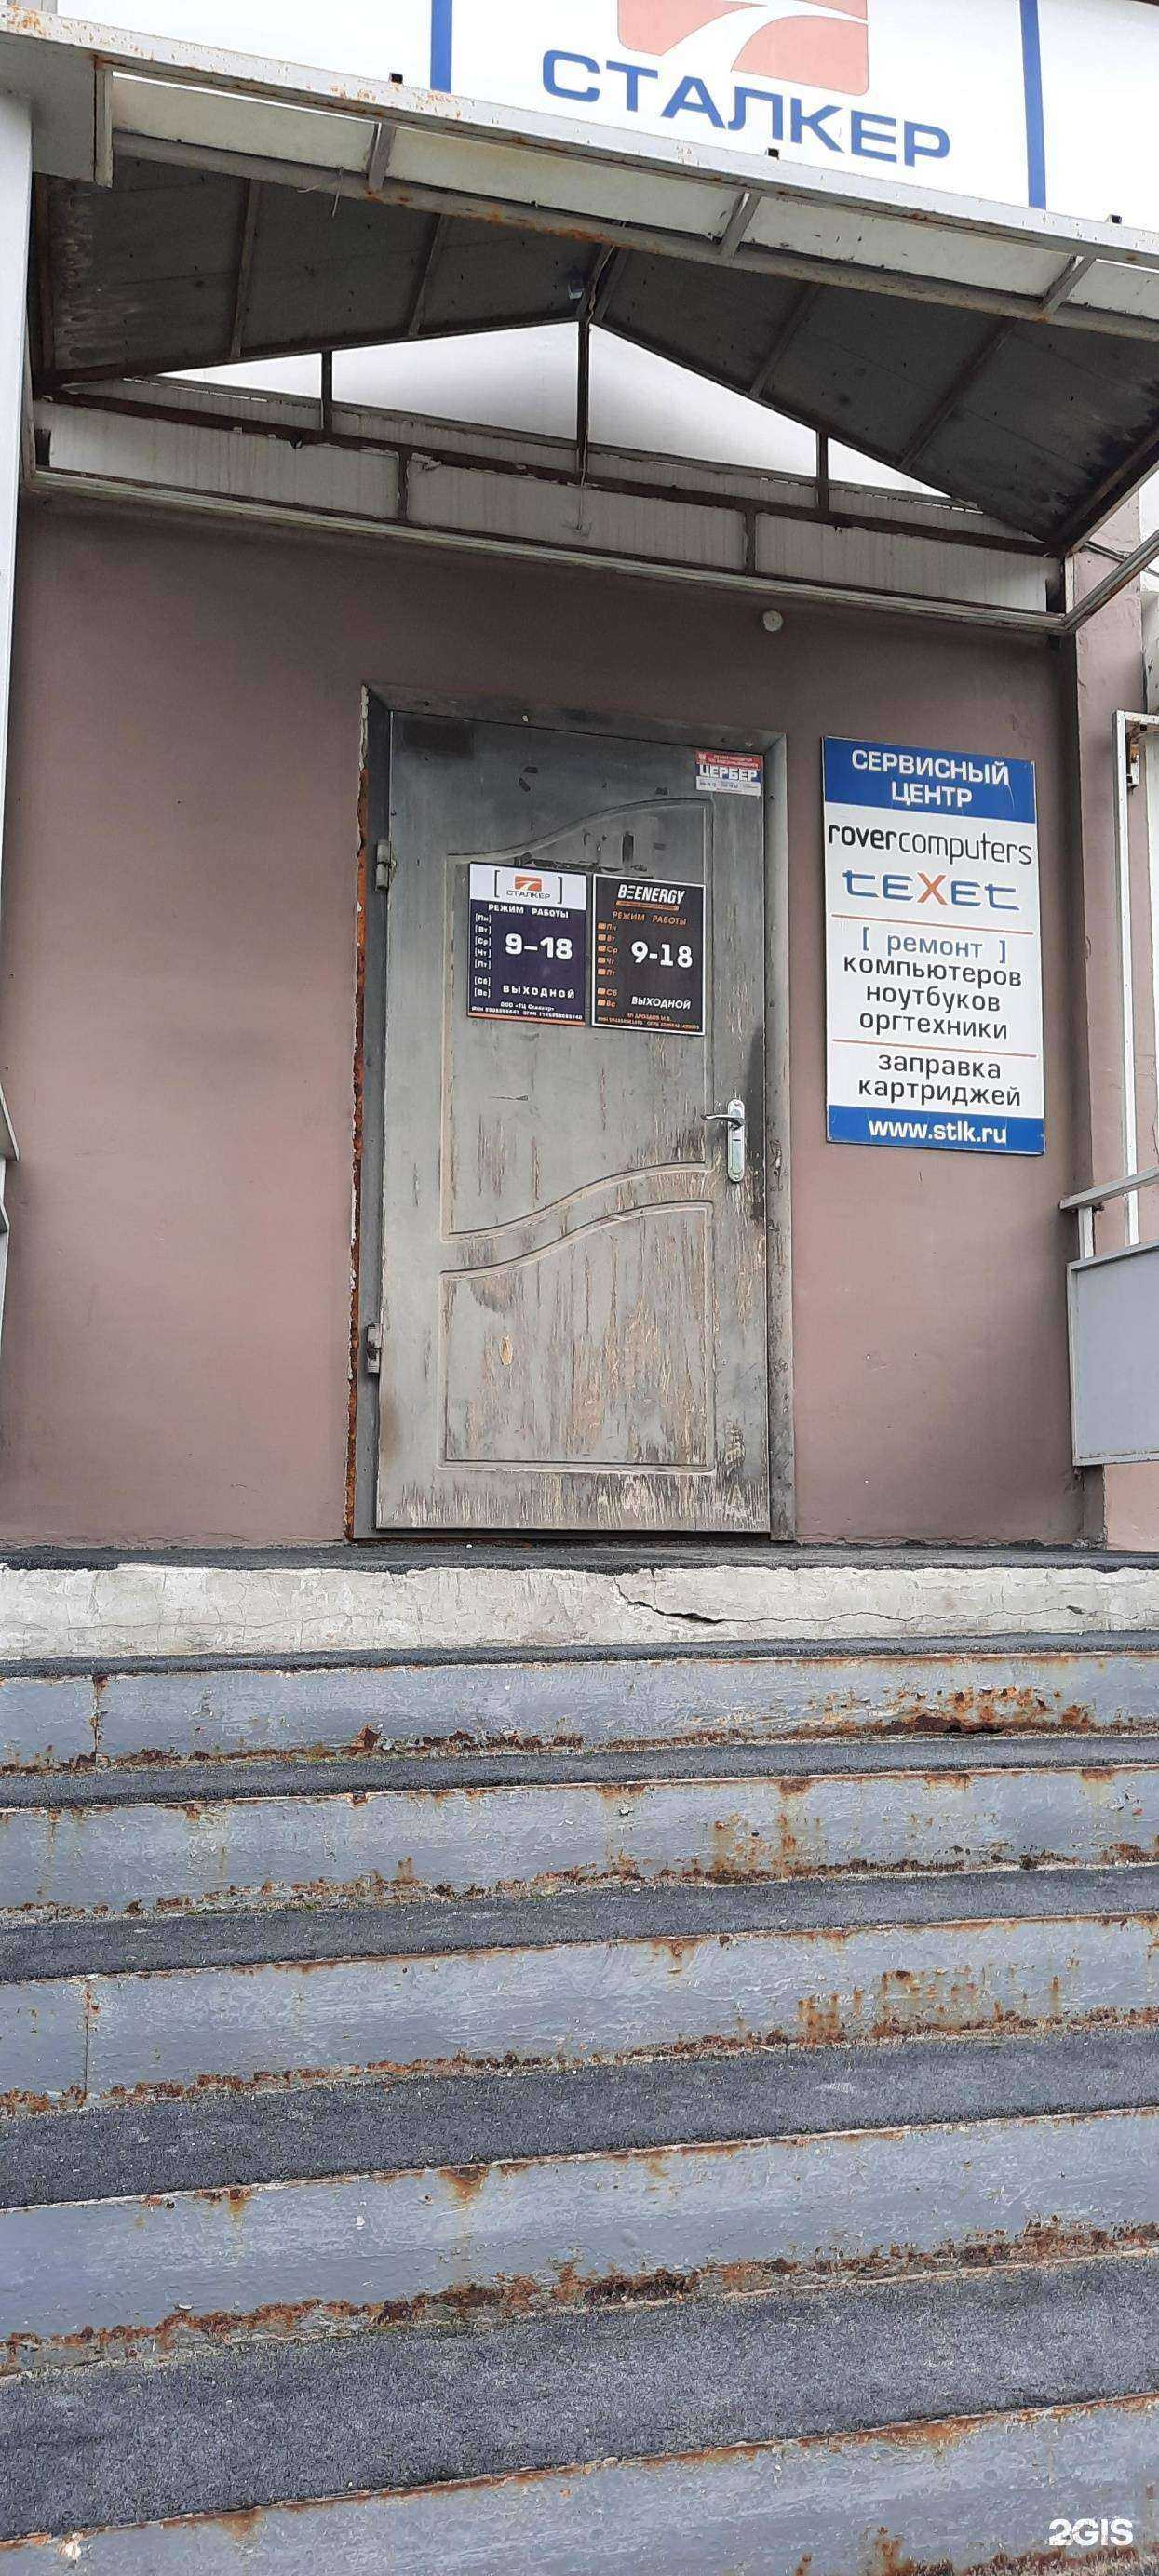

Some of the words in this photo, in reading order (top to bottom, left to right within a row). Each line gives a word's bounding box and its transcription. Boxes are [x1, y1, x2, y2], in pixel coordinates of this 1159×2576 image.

[542, 49, 950, 168] СТАЛКЕР
[699, 764, 758, 782] ЦЕРБЕР
[851, 749, 1010, 785] СЕРВИСНЫЙ
[891, 781, 973, 808] ЦЕНТР
[828, 824, 1032, 865] rovercomputers
[506, 890, 551, 900] СТАЛКЕР
[488, 904, 524, 914] РЕЖИМ
[532, 907, 569, 919] РАБОТЫ
[612, 910, 645, 921] РЕЖИМ
[652, 915, 687, 926] РАБОТЫ
[631, 940, 693, 968] 9-18
[887, 933, 983, 958] ремонт
[843, 956, 1022, 989] компьютеров
[503, 985, 575, 999] ВЫХОДНОЙ
[631, 996, 692, 1010] ВЫХОДНОЙ
[866, 985, 1001, 1013] ноутбуков
[859, 1012, 1008, 1040] оргтехники
[878, 1054, 1002, 1080] заправка
[858, 1080, 1021, 1107] картриджей
[869, 1120, 1008, 1144] www.stlk.ru
